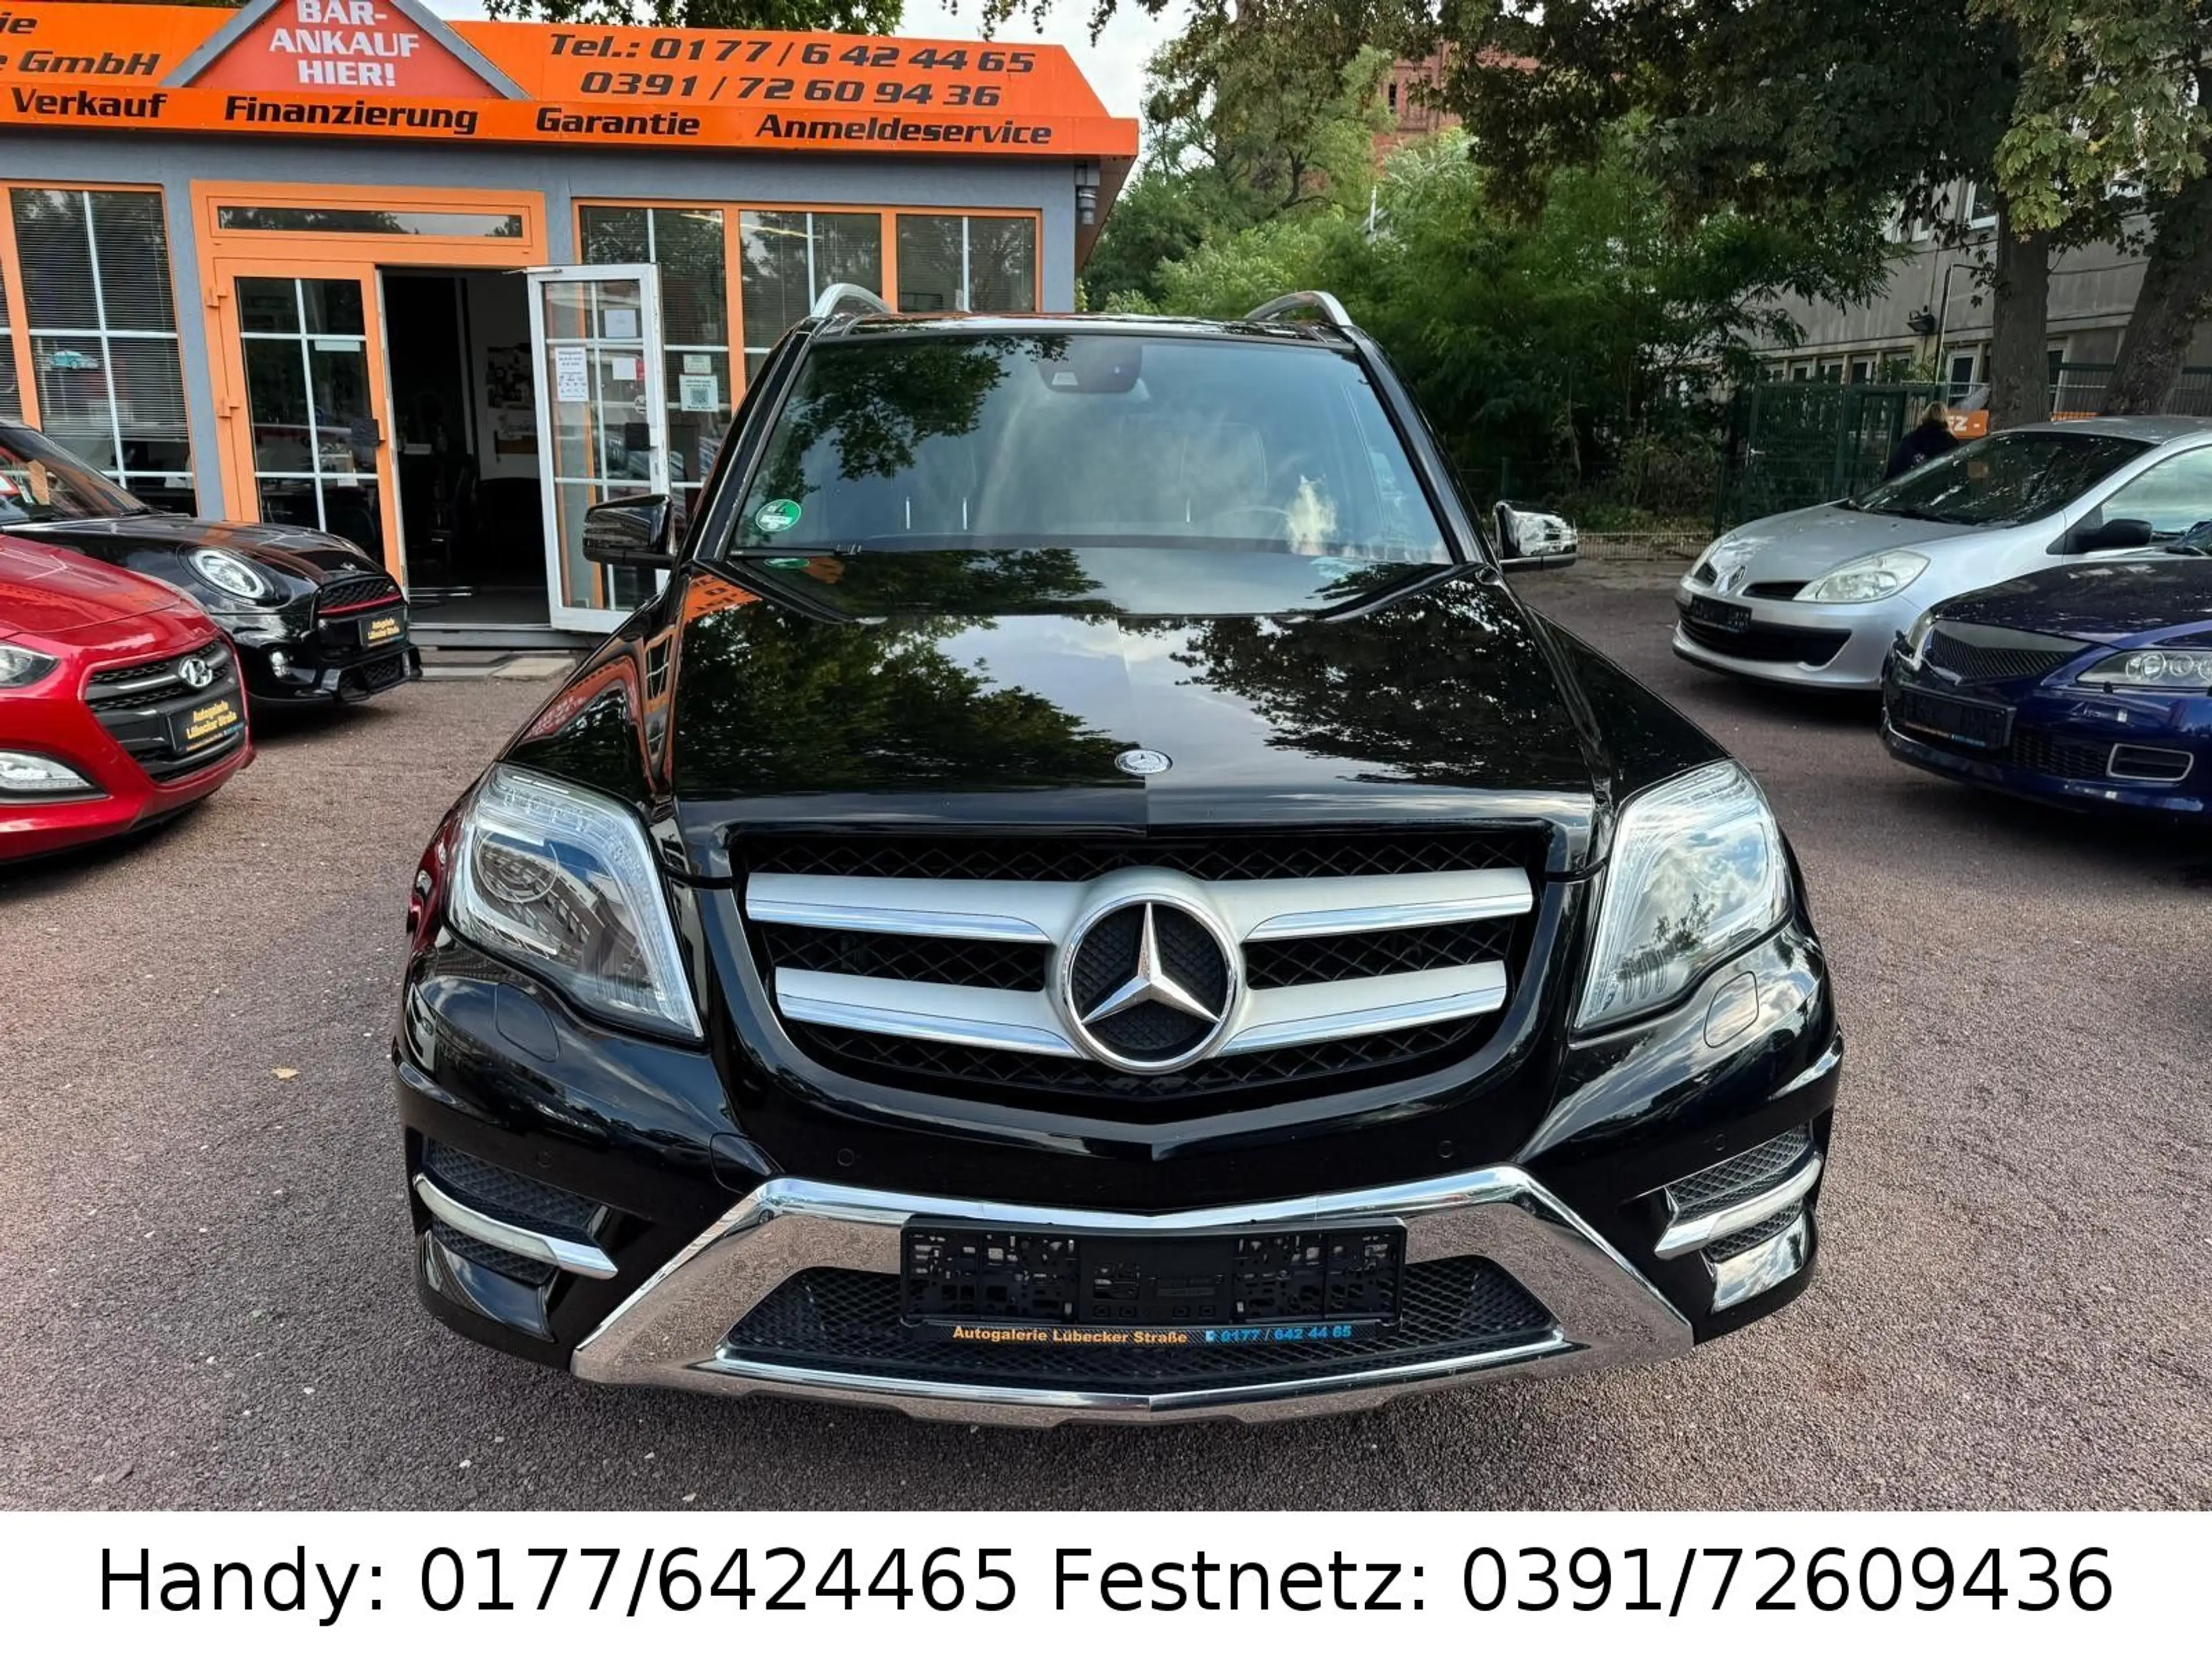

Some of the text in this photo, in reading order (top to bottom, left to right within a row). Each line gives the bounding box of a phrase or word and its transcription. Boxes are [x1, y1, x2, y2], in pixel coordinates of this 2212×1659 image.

[297, 0, 388, 26] BAR-
[270, 28, 421, 58] ANKAUF
[551, 33, 641, 58] Tel.:
[650, 37, 772, 62] 0177
[801, 43, 831, 65] 6
[839, 45, 900, 67] 42
[908, 48, 968, 70] 44
[978, 51, 1036, 73] 65
[18, 50, 161, 76] GmbH
[298, 60, 396, 87] HIER!
[580, 71, 698, 96] 0391
[737, 77, 795, 100] 72
[804, 79, 865, 102] 60
[873, 82, 933, 104] 94
[943, 85, 1002, 107] 36
[11, 87, 1052, 144] Verkauf Finanzierung Garantie Anmeldeservice
[953, 1325, 1048, 1343] Autogalerie
[1053, 1328, 1130, 1343] Lübecker
[1133, 1330, 1188, 1343] Straße
[1221, 1329, 1260, 1342] 0177
[1274, 1327, 1304, 1340] 642
[1308, 1327, 1328, 1339] 44
[1332, 1325, 1352, 1338] 65
